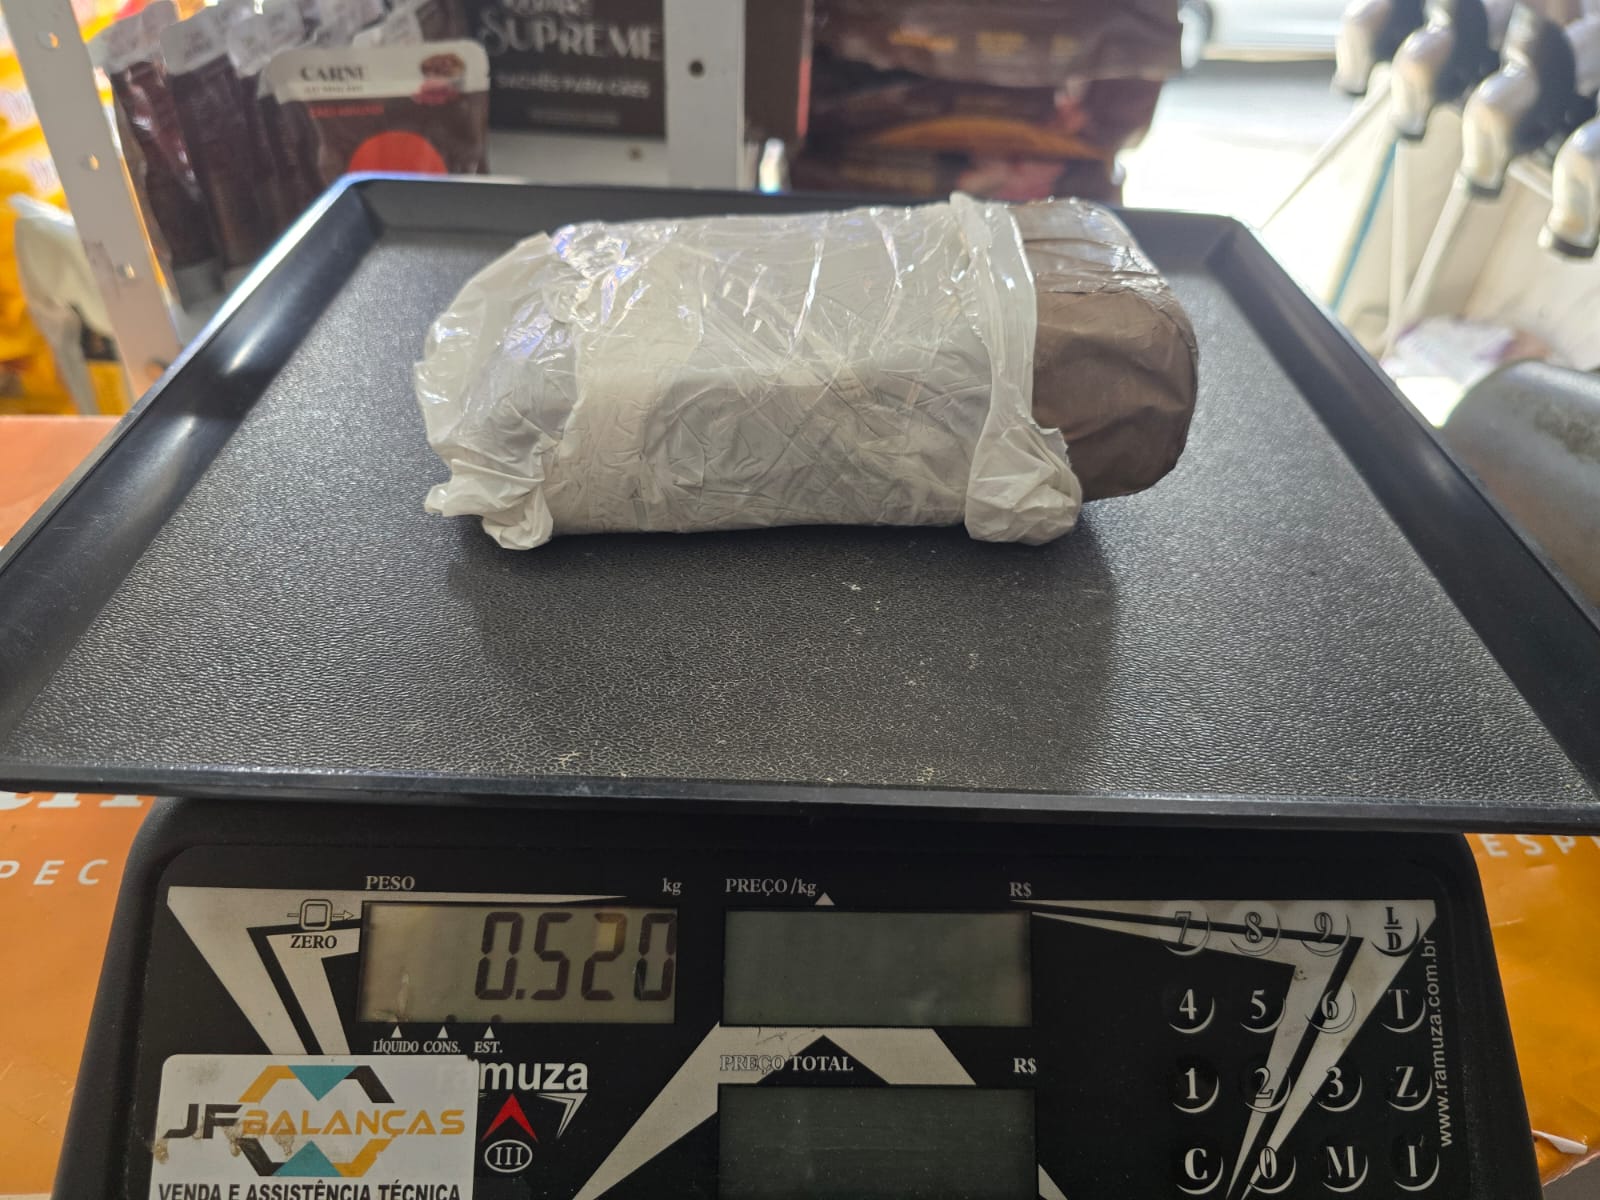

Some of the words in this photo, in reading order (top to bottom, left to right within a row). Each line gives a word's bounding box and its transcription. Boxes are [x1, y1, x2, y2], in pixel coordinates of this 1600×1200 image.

[366, 876, 415, 890] PESO
[662, 878, 682, 896] kg
[725, 879, 787, 896] PREÇO
[1009, 882, 1032, 897] R$
[1175, 911, 1192, 944] 7
[1244, 912, 1264, 943] 8
[1313, 912, 1333, 943] 9
[1386, 907, 1399, 924] L
[290, 935, 338, 949] ZERO
[1386, 931, 1402, 950] D
[475, 912, 676, 1001] 0.520
[1178, 989, 1198, 1021] 4
[1250, 990, 1267, 1020] 5
[1320, 990, 1339, 1020] 6
[1387, 989, 1409, 1020] T
[373, 1039, 419, 1054] LÍQUIDO
[423, 1040, 461, 1054] CONS.
[474, 1040, 503, 1054] EST.
[1421, 936, 1453, 1147] www.ramuza.com.br
[719, 1055, 784, 1074] PREÇO
[789, 1055, 854, 1072] TOTAL
[1013, 1057, 1037, 1074] R$
[1185, 1067, 1199, 1100] 1
[1254, 1066, 1274, 1100] 2
[1325, 1066, 1344, 1098] 3
[1395, 1066, 1419, 1098] Z
[494, 1146, 523, 1166] III
[1184, 1147, 1208, 1180] C
[1326, 1146, 1356, 1178] M
[158, 1184, 221, 1200] VENDA
[229, 1184, 240, 1200] E
[246, 1179, 371, 1200] ASSISTÊNCIA
[378, 1179, 460, 1200] TÉCNICA
